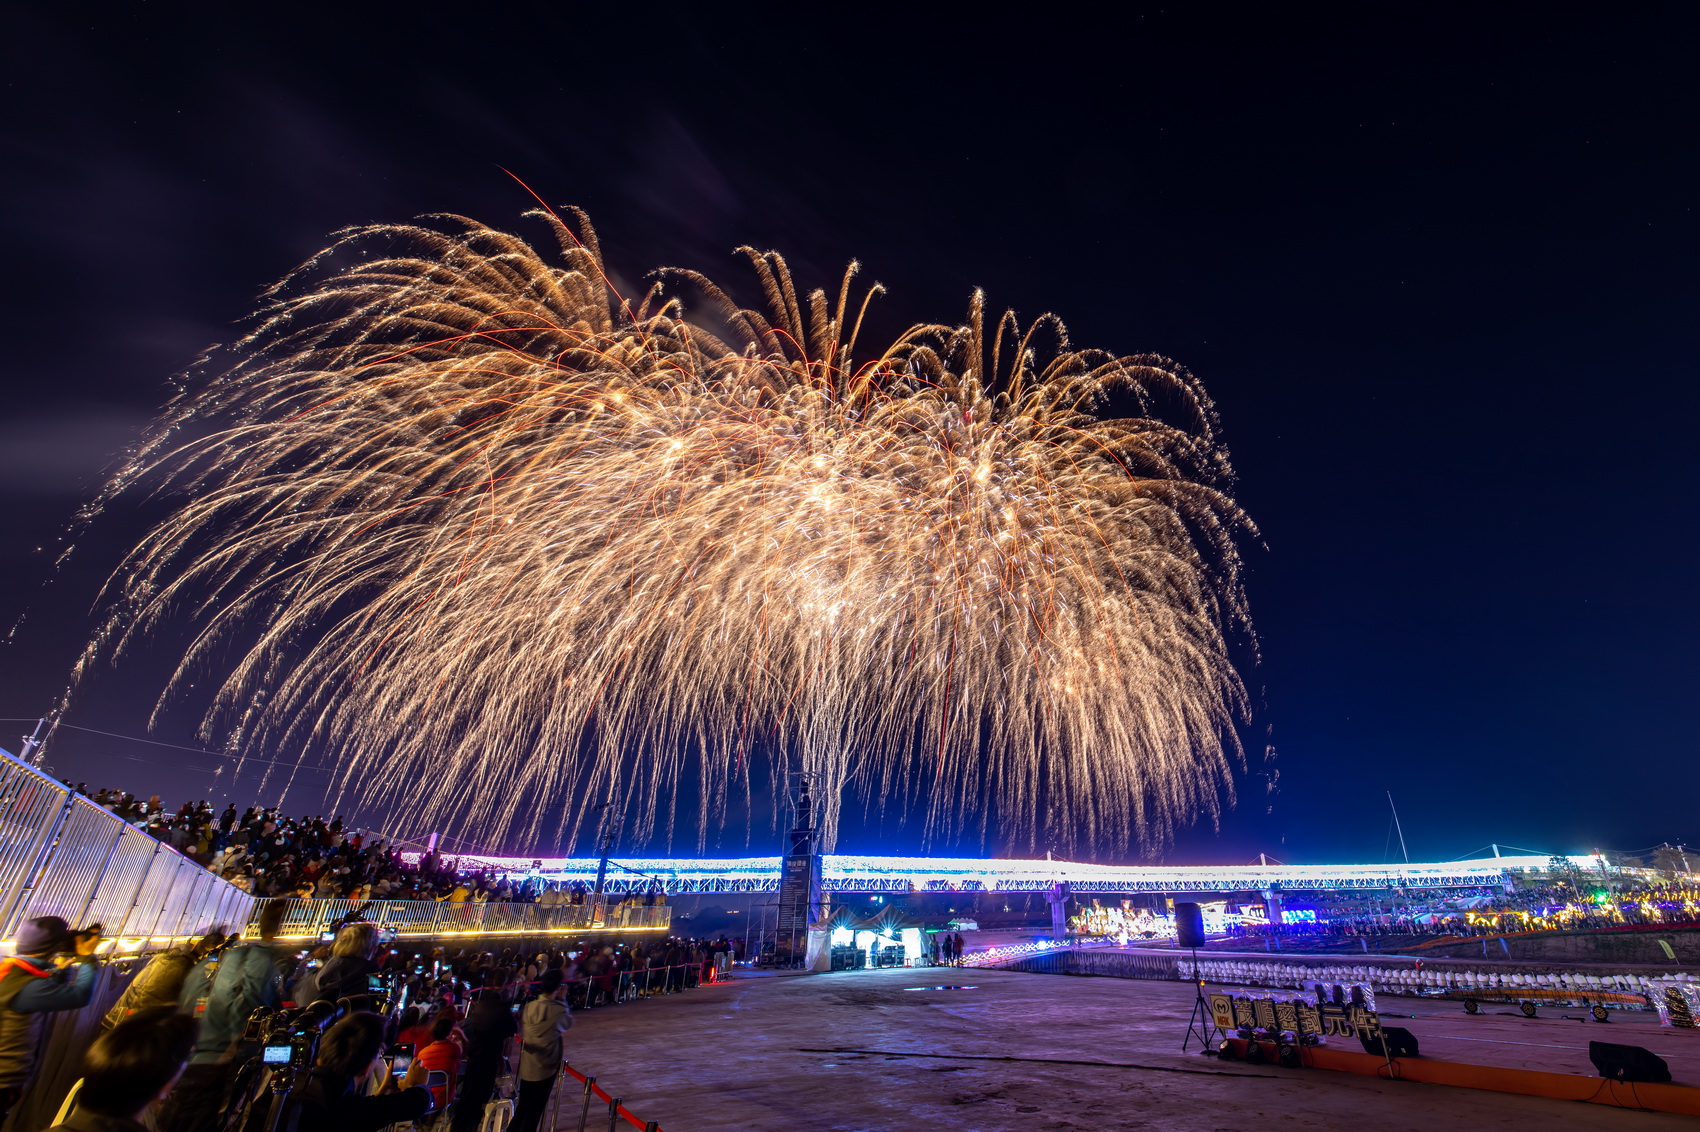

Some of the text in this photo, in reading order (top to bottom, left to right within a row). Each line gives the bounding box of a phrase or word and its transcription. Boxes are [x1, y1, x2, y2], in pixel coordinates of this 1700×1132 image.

[1232, 999, 1377, 1040] 茂順密封元件
